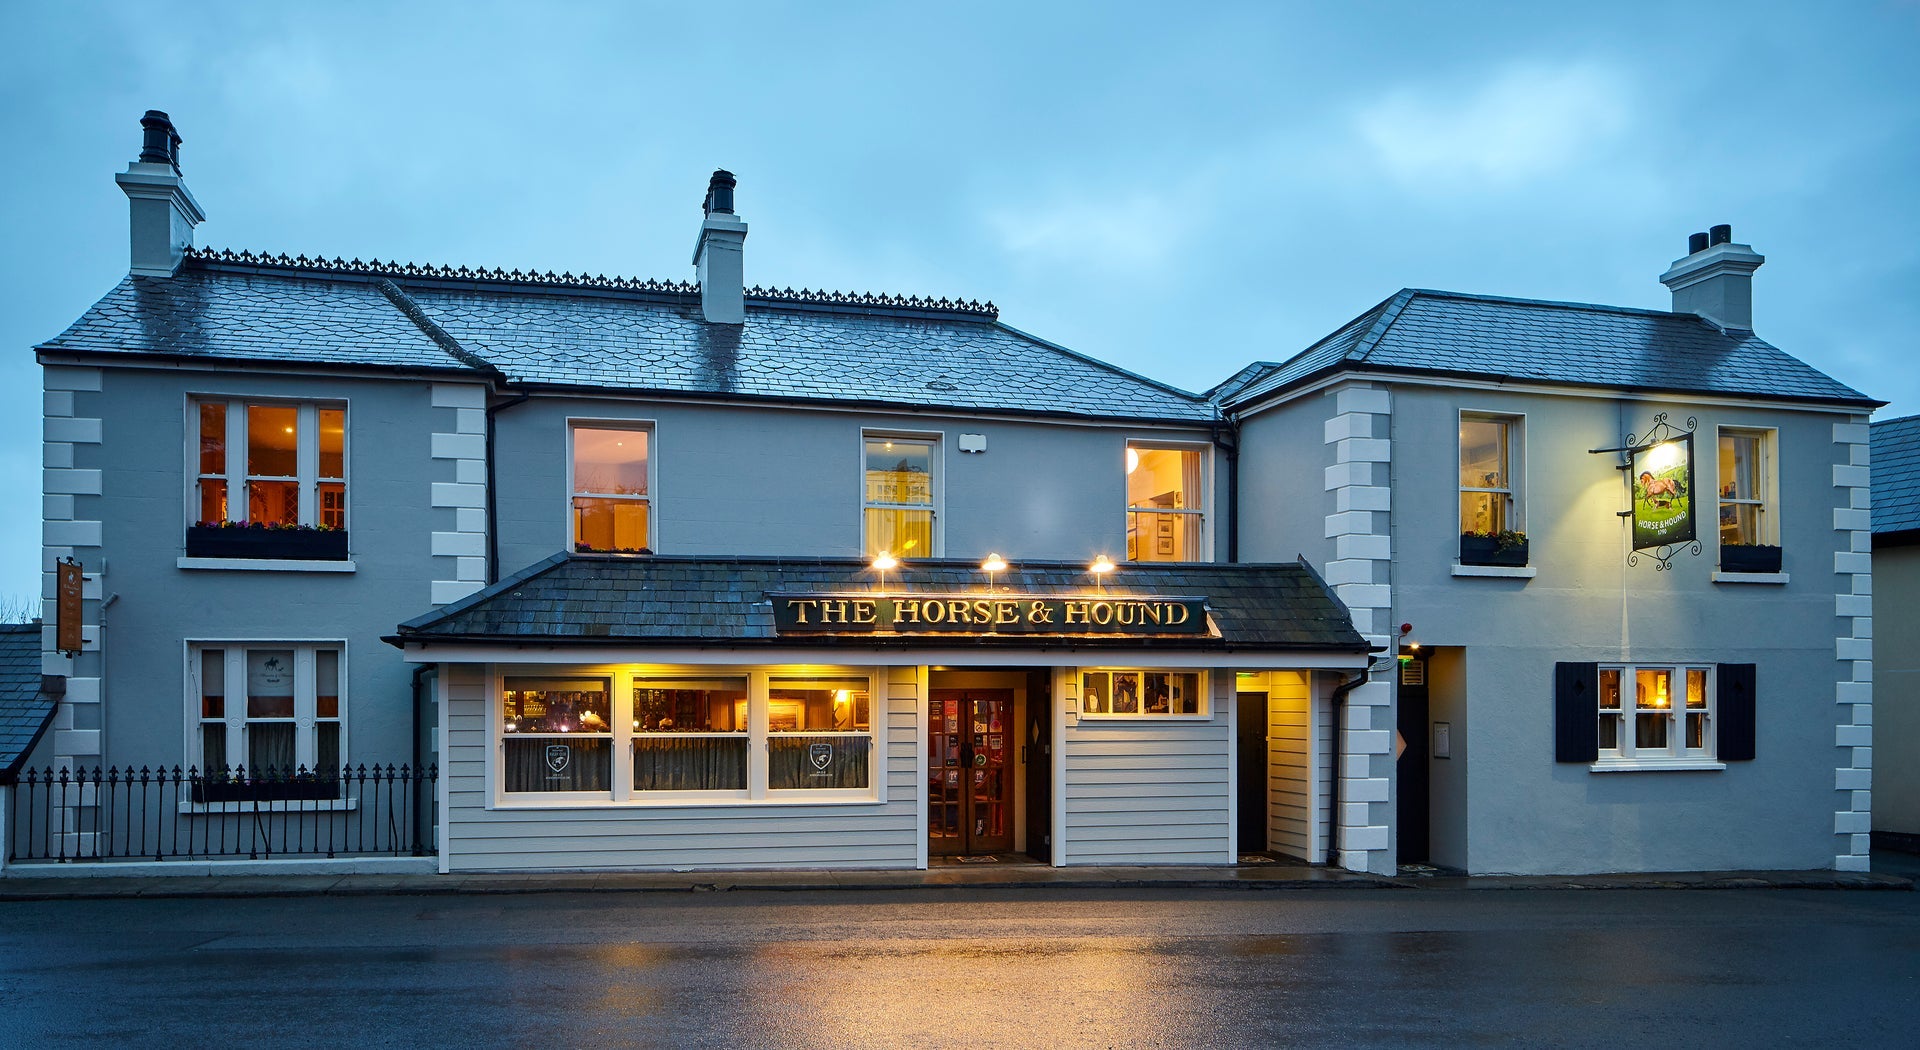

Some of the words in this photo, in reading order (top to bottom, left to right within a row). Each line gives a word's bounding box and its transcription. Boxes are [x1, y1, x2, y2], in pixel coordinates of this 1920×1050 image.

[1638, 520, 1659, 529] HORSE
[1665, 511, 1686, 527] HOUND
[787, 599, 877, 624] THE
[892, 599, 1021, 625] HORSE
[1027, 600, 1054, 625] &
[1064, 601, 1190, 626] HOUND
